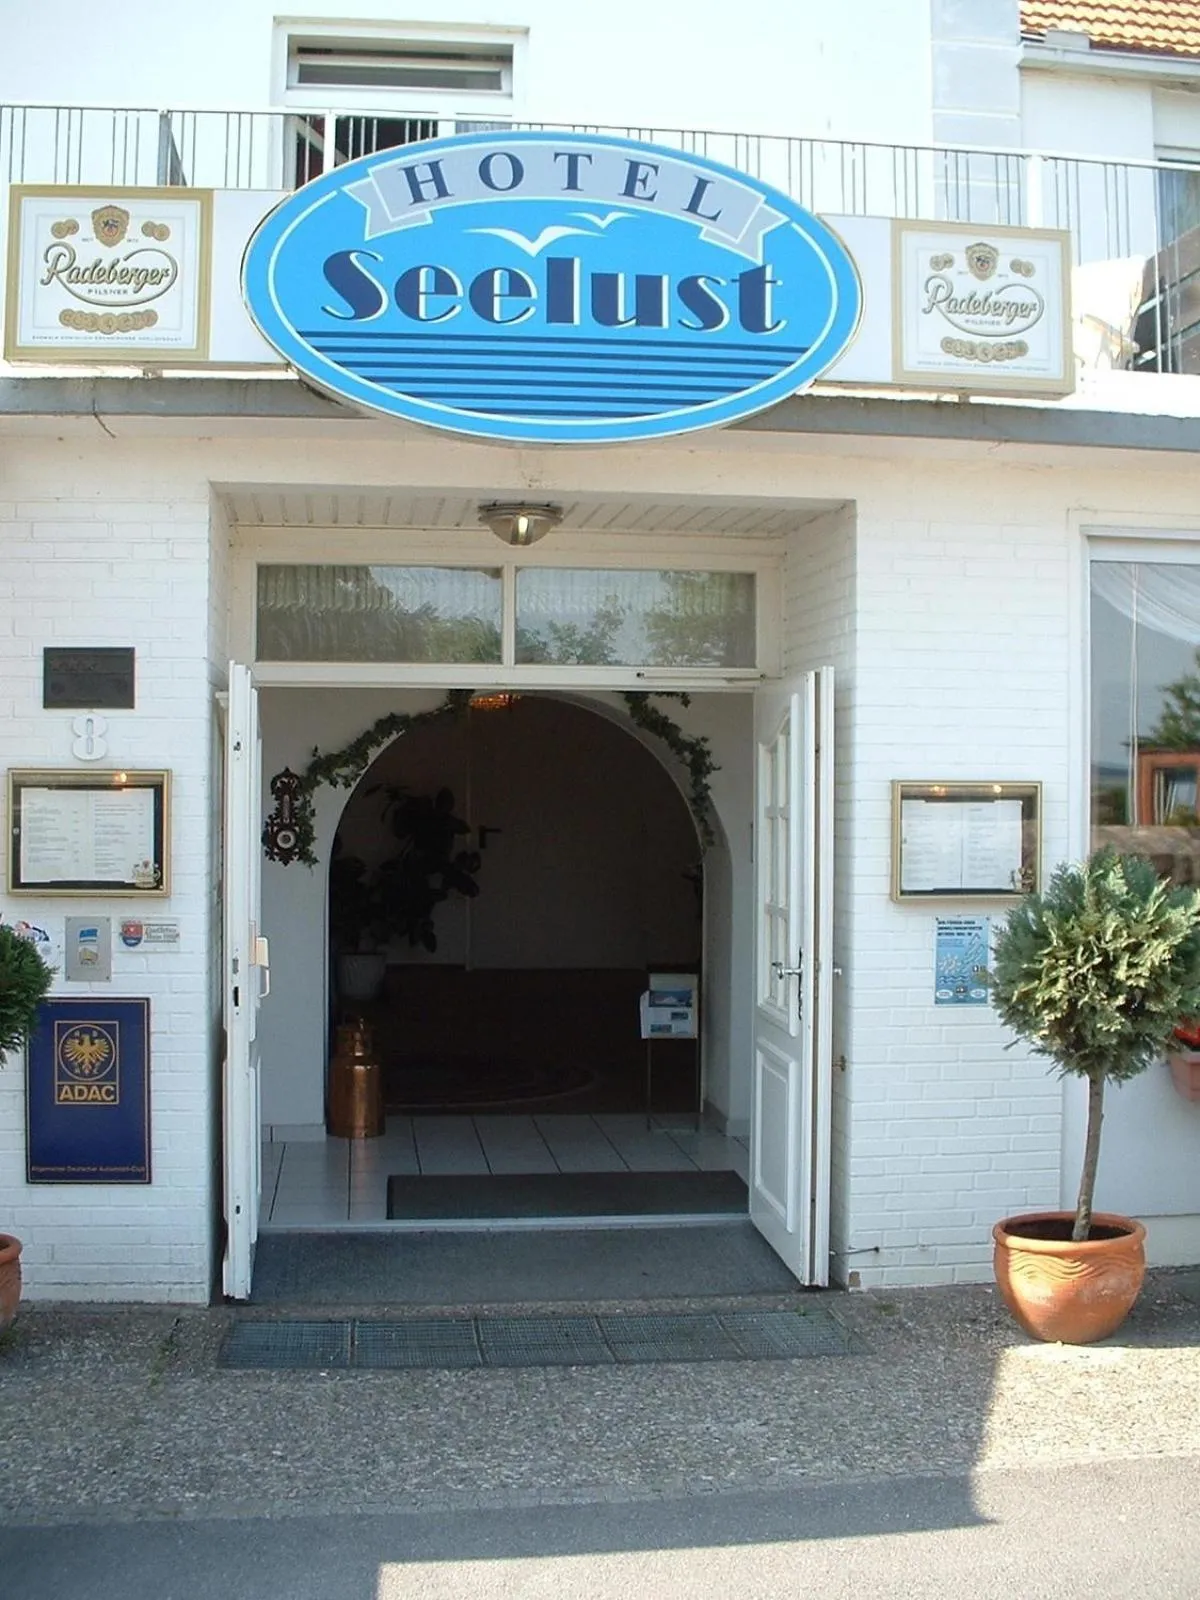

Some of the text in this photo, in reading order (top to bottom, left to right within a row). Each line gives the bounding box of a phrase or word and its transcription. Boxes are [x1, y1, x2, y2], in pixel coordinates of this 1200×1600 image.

[398, 151, 724, 222] HOTEL
[40, 241, 178, 306] Radeberger
[321, 249, 788, 335] Seelust
[921, 275, 1045, 337] Radeberger
[72, 712, 108, 761] 8
[59, 1085, 116, 1101] ADAC
